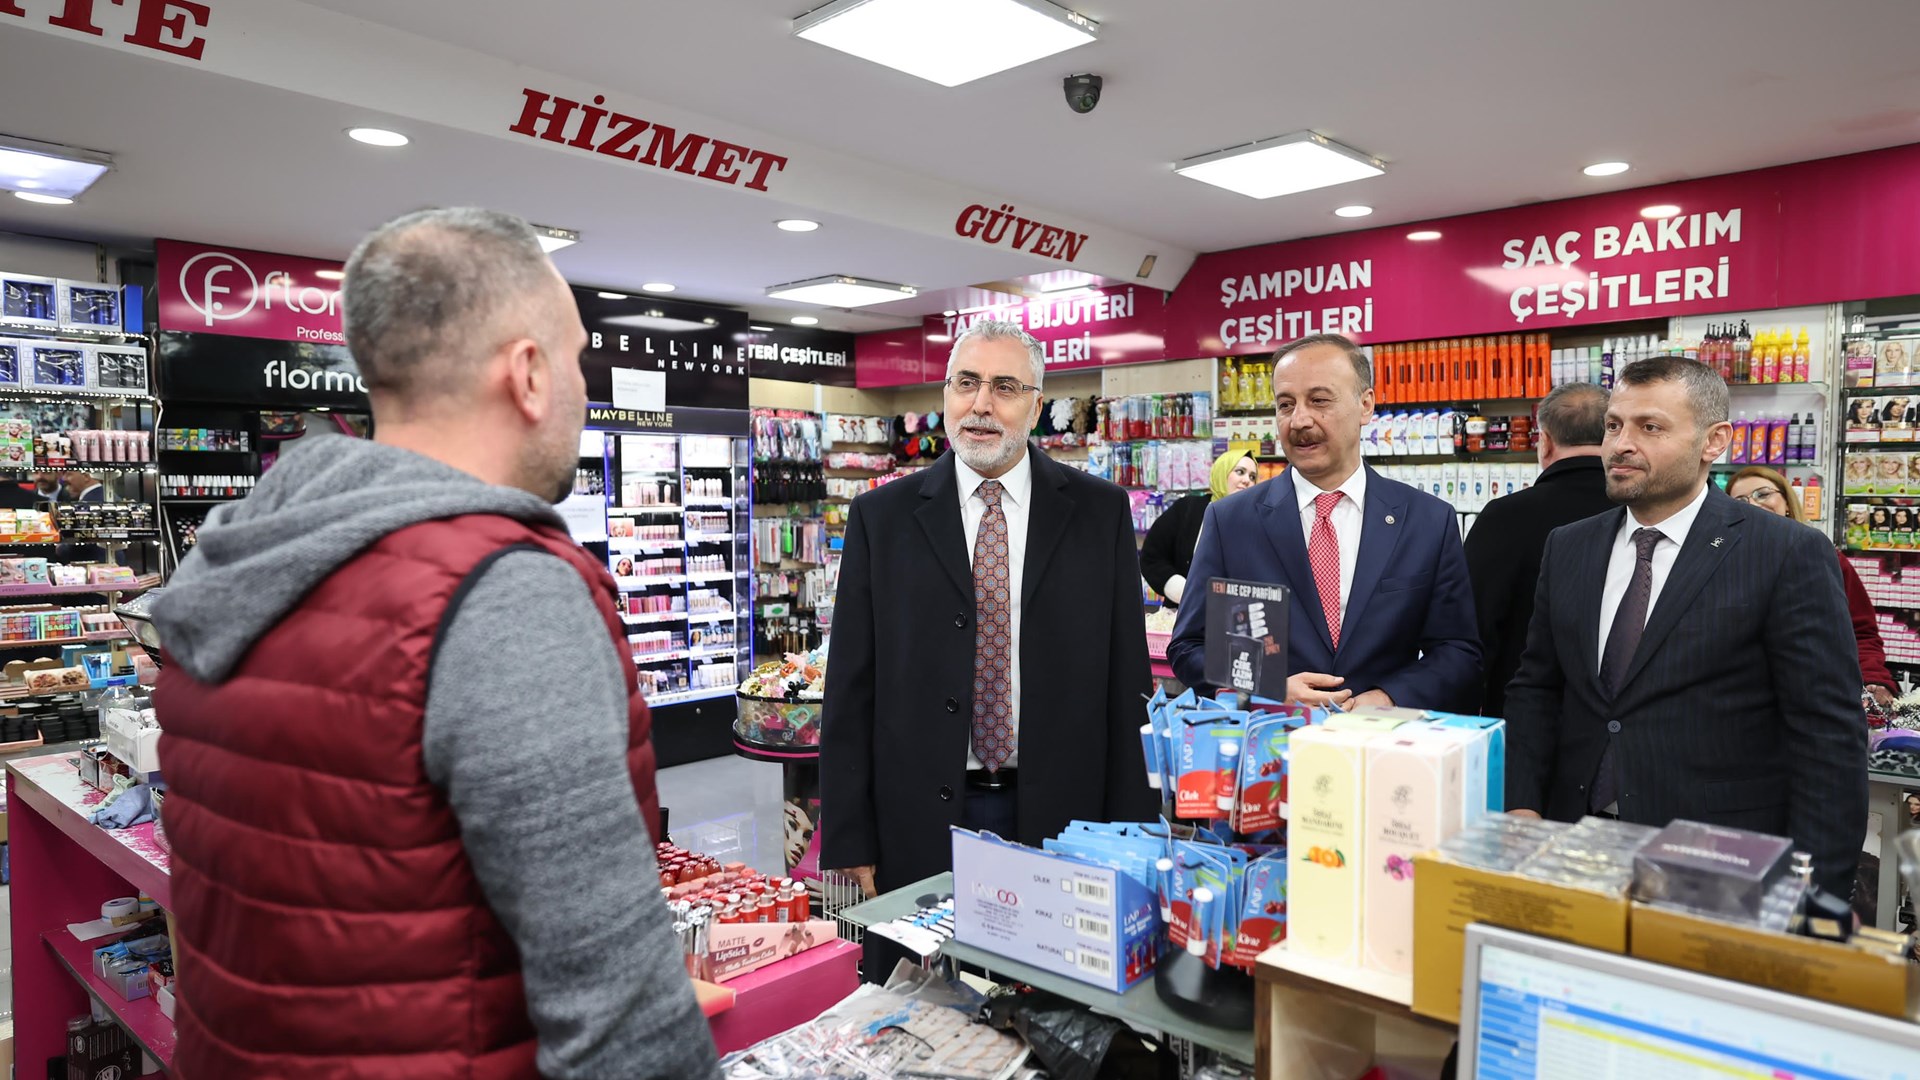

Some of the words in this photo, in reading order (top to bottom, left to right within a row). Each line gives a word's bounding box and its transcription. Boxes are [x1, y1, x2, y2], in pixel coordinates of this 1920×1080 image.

[509, 88, 788, 191] HİZMET
[955, 203, 1088, 263] GÜVEN
[1502, 231, 1581, 270] SAÇ
[1594, 208, 1742, 260] BAKIM
[1220, 259, 1372, 309] ŞAMPUAN
[1509, 256, 1730, 323] ÇEŞİTLERİ
[1220, 297, 1373, 349] ÇEŞİTLERİ
[781, 347, 847, 367] ÇEŞİTLERİ
[590, 408, 673, 423] MAYBELLINE
[47, 623, 75, 631] SASSY
[715, 946, 747, 962] LipStick
[717, 936, 746, 949] MATTE
